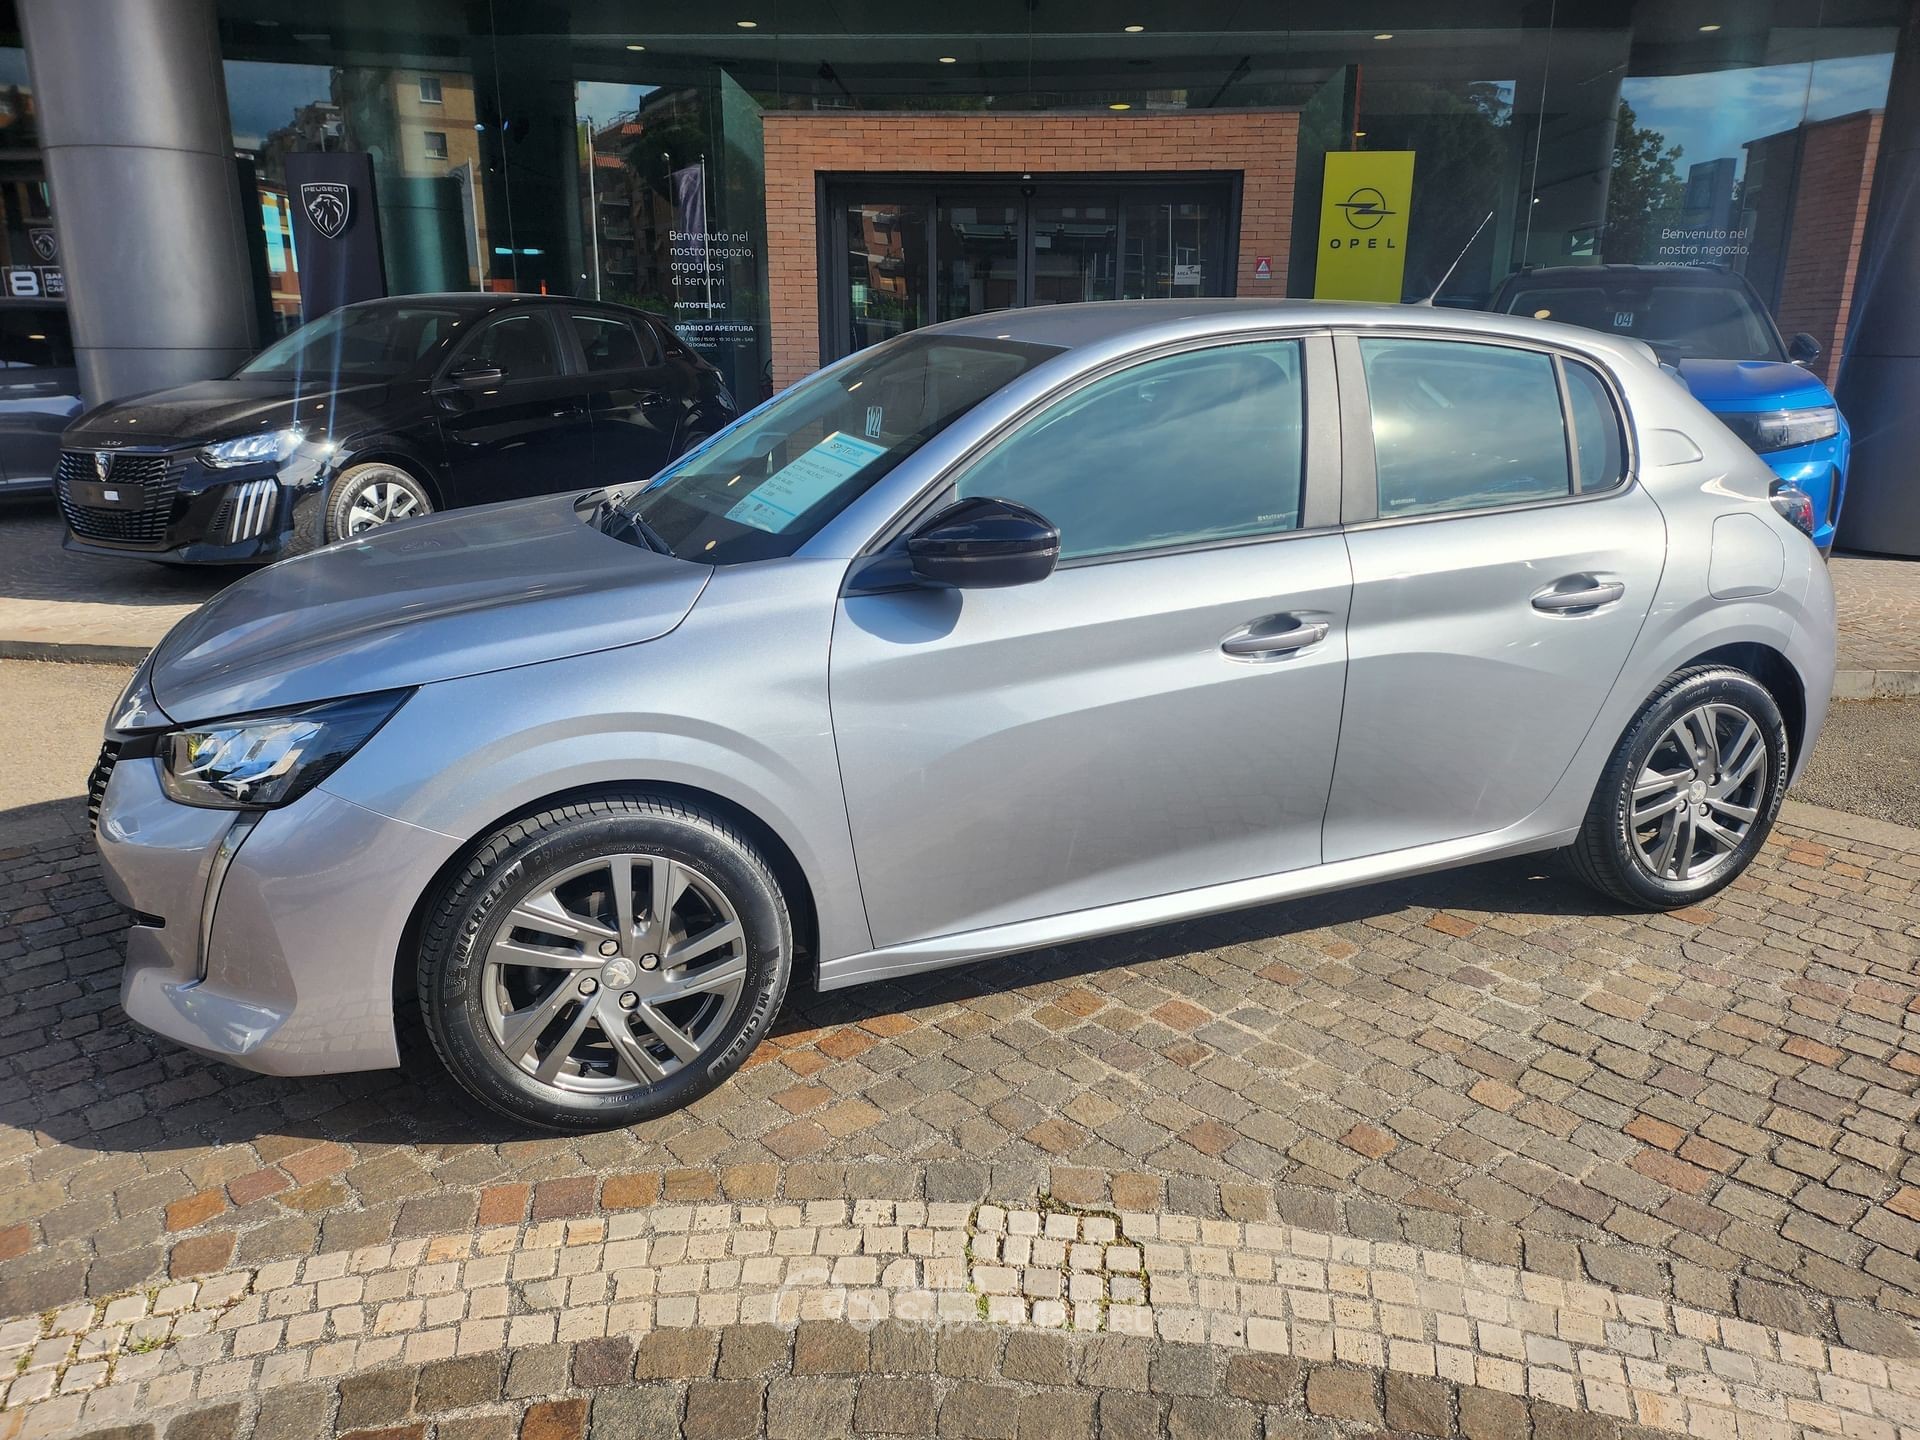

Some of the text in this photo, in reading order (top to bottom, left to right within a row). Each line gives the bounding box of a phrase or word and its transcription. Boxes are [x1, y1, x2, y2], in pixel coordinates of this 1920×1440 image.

[669, 230, 749, 242] Benvenuto nel
[1661, 228, 1748, 240] Benvenuto nel
[1330, 238, 1396, 249] OPEL
[1659, 243, 1751, 257] nostro negozio,
[670, 246, 754, 259] nostro negozio,
[670, 260, 724, 273] orgoglosi
[10, 271, 39, 296] 8
[671, 274, 682, 286] di
[1615, 312, 1633, 326] 04
[674, 324, 704, 332] ORARIO
[867, 406, 881, 437] 122
[454, 868, 522, 963] MICHELIN
[713, 992, 770, 1077] MICHELIN
